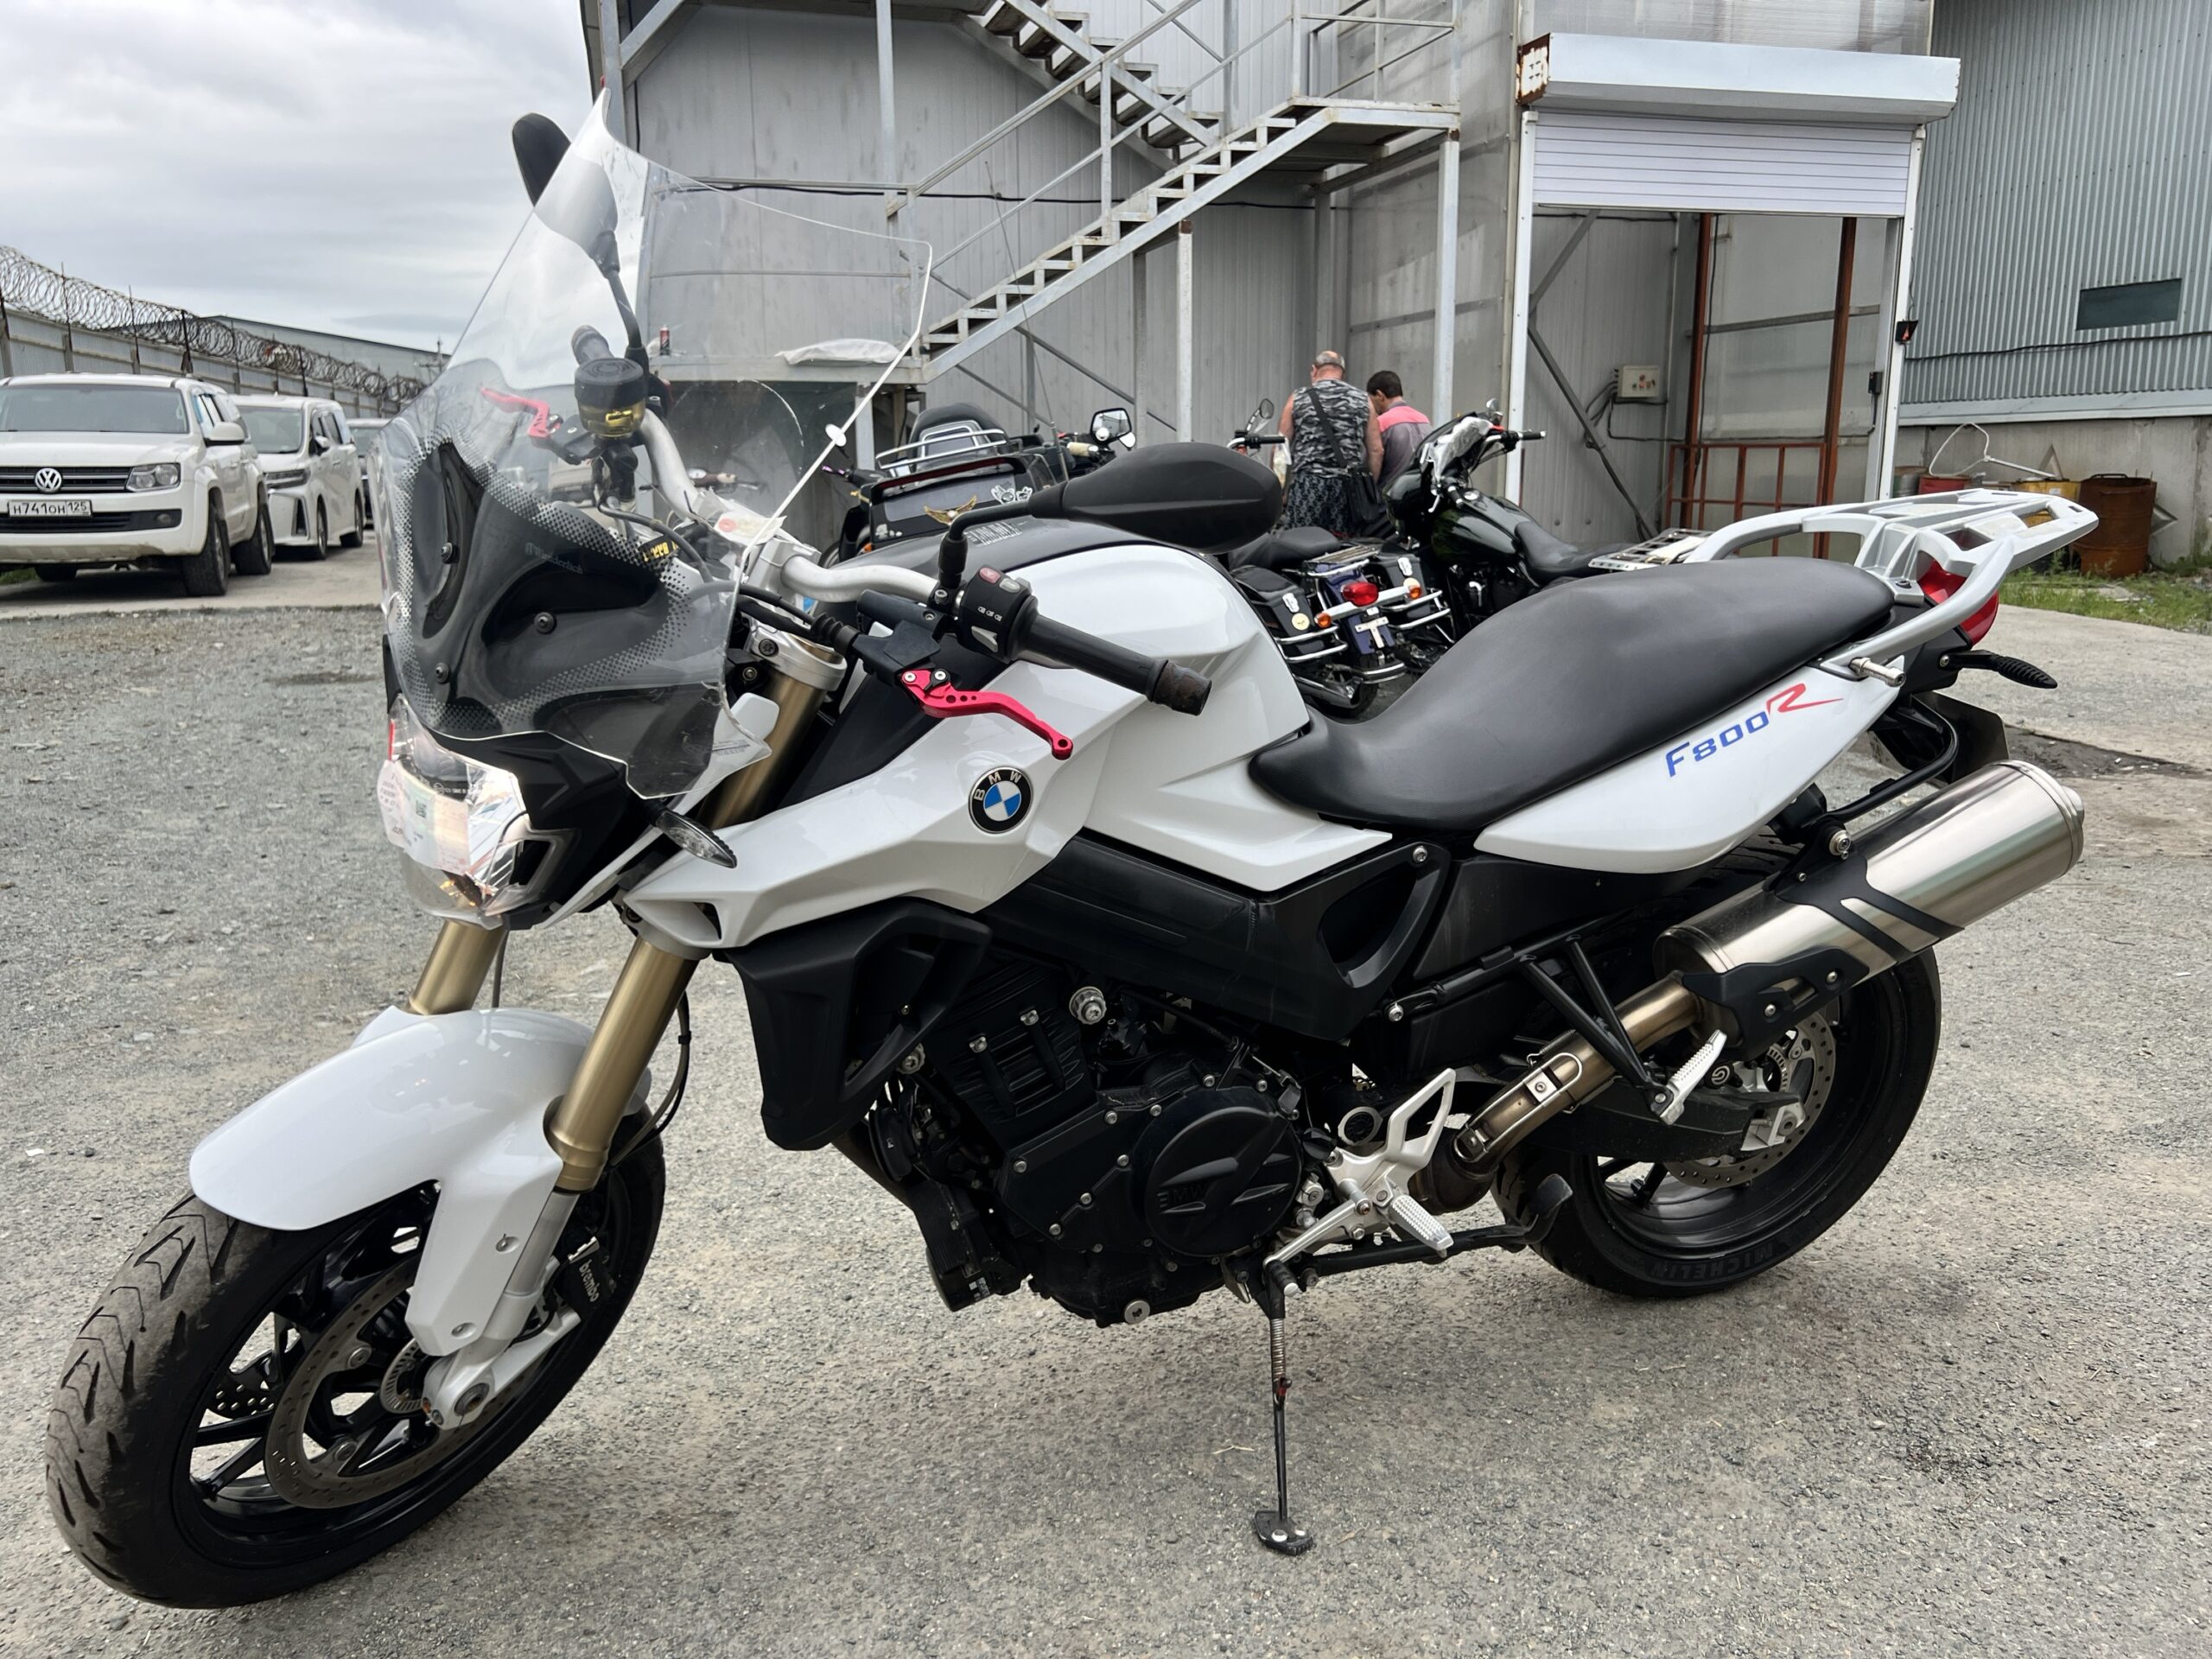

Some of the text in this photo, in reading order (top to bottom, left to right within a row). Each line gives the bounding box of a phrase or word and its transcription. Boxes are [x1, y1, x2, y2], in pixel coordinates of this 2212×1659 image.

[68, 501, 87, 512] 125
[973, 770, 1021, 802] BMW
[1648, 1242, 1775, 1281] MICHELIN
[578, 1258, 601, 1303] brembo
